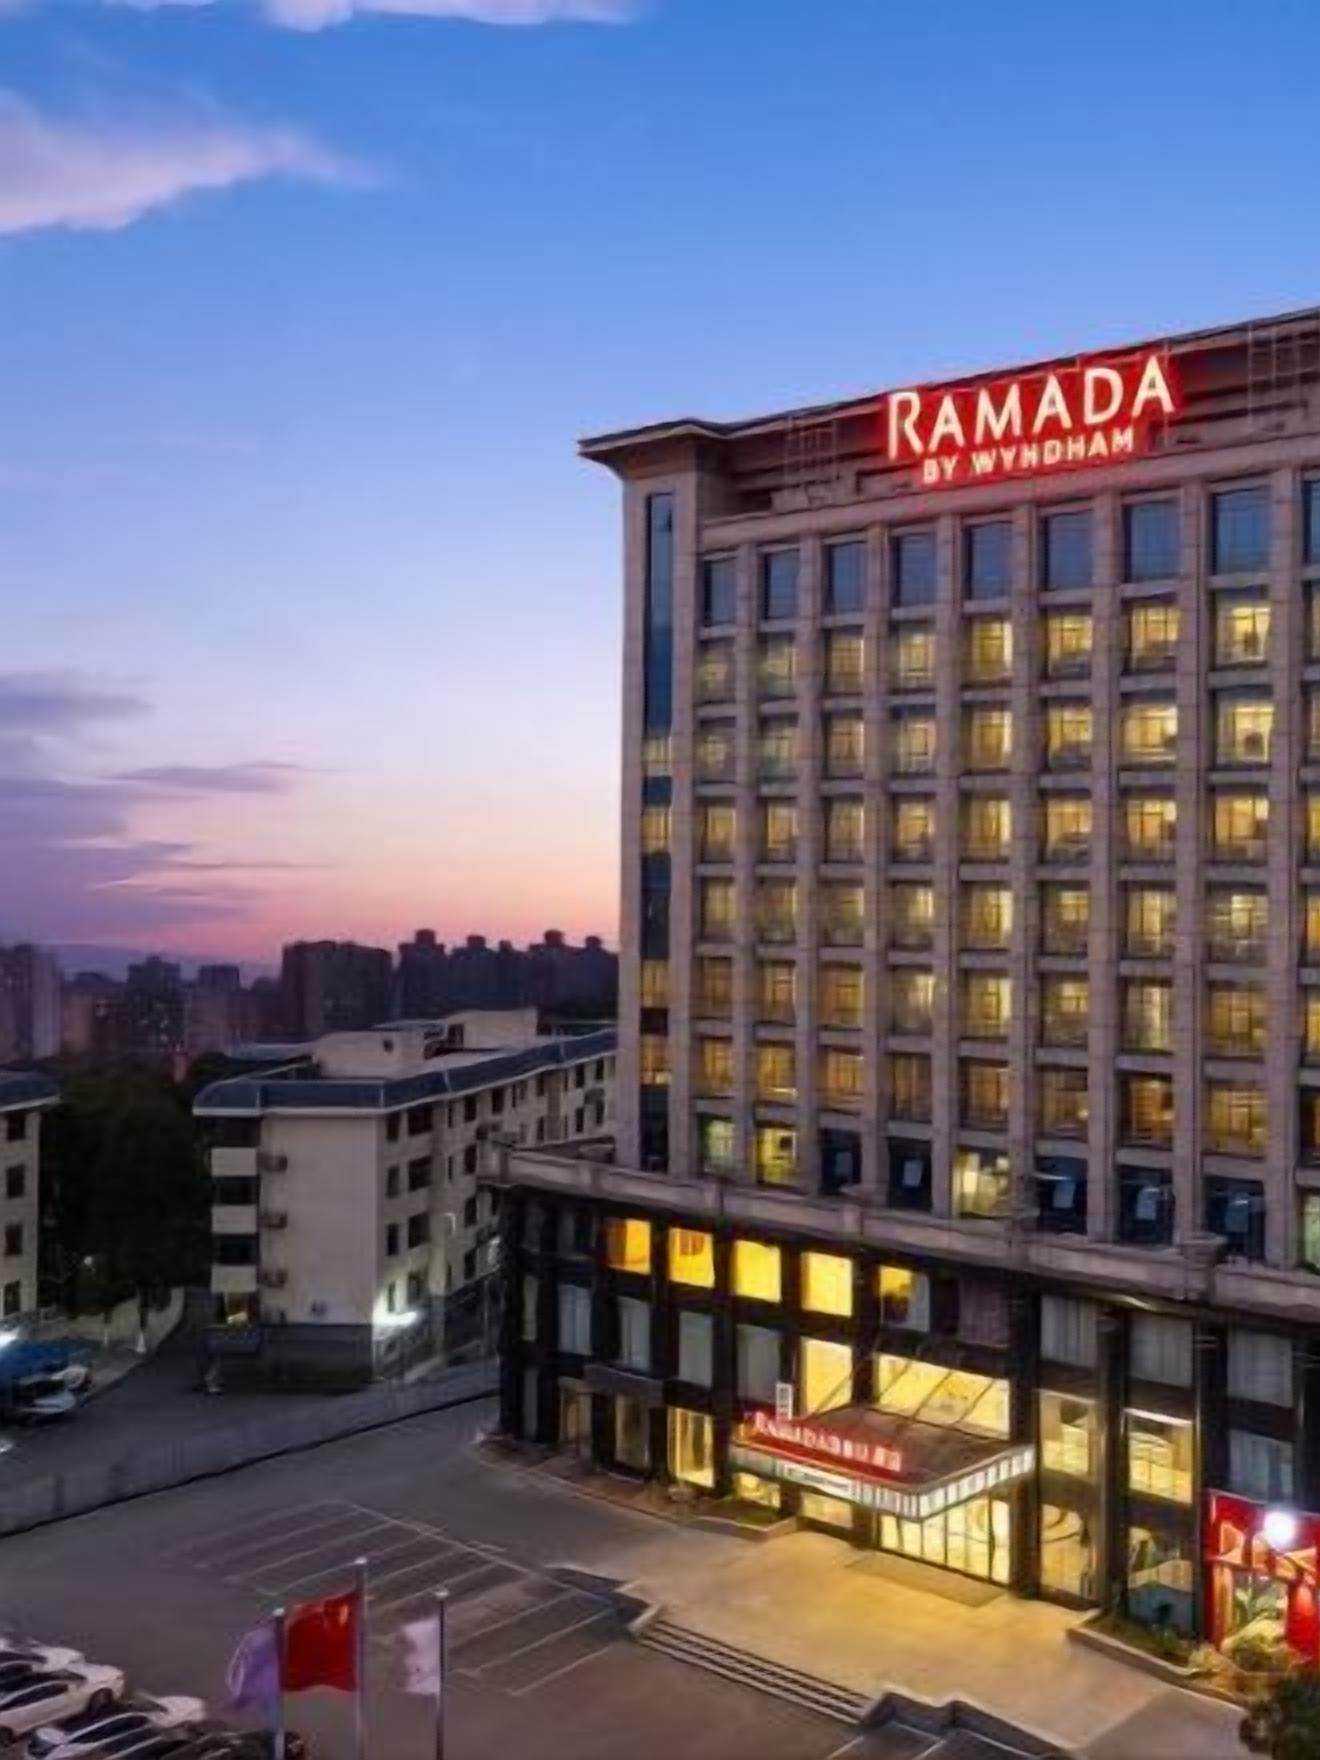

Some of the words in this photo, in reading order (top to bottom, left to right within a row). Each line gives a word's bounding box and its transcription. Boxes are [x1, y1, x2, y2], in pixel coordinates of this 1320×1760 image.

[887, 354, 1175, 460] RAMADA
[922, 454, 960, 484] BY
[970, 426, 1134, 476] WYNDHAM
